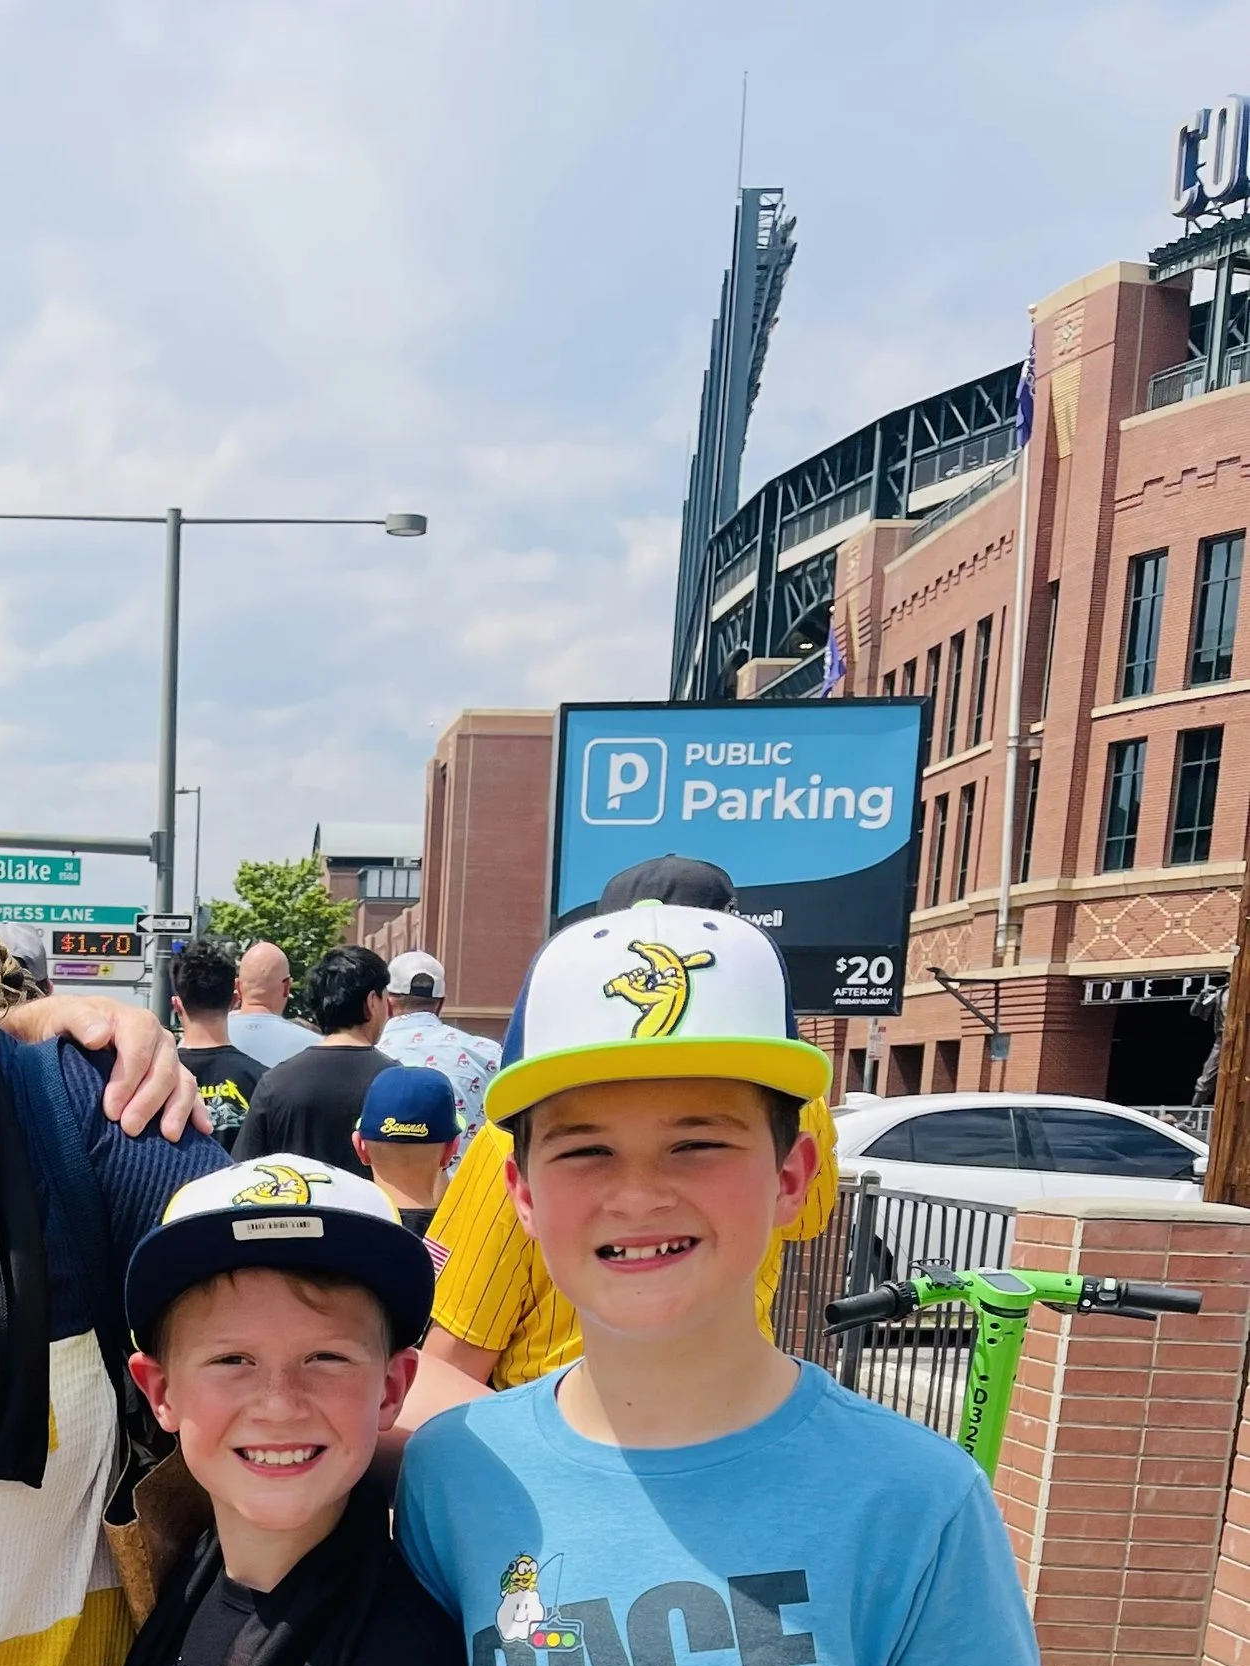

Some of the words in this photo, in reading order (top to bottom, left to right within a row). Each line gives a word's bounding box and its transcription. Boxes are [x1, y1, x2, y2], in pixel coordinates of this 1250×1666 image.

[685, 742, 793, 766] PUBLIC
[681, 774, 894, 830] Parking
[50, 907, 94, 921] LANE
[739, 909, 784, 927] well
[60, 933, 131, 954] $1.70
[835, 956, 894, 985] $20
[833, 988, 868, 997] AFTER
[869, 987, 893, 996] 4PM
[1085, 979, 1154, 1002] HOME
[380, 1117, 429, 1136] Bananas
